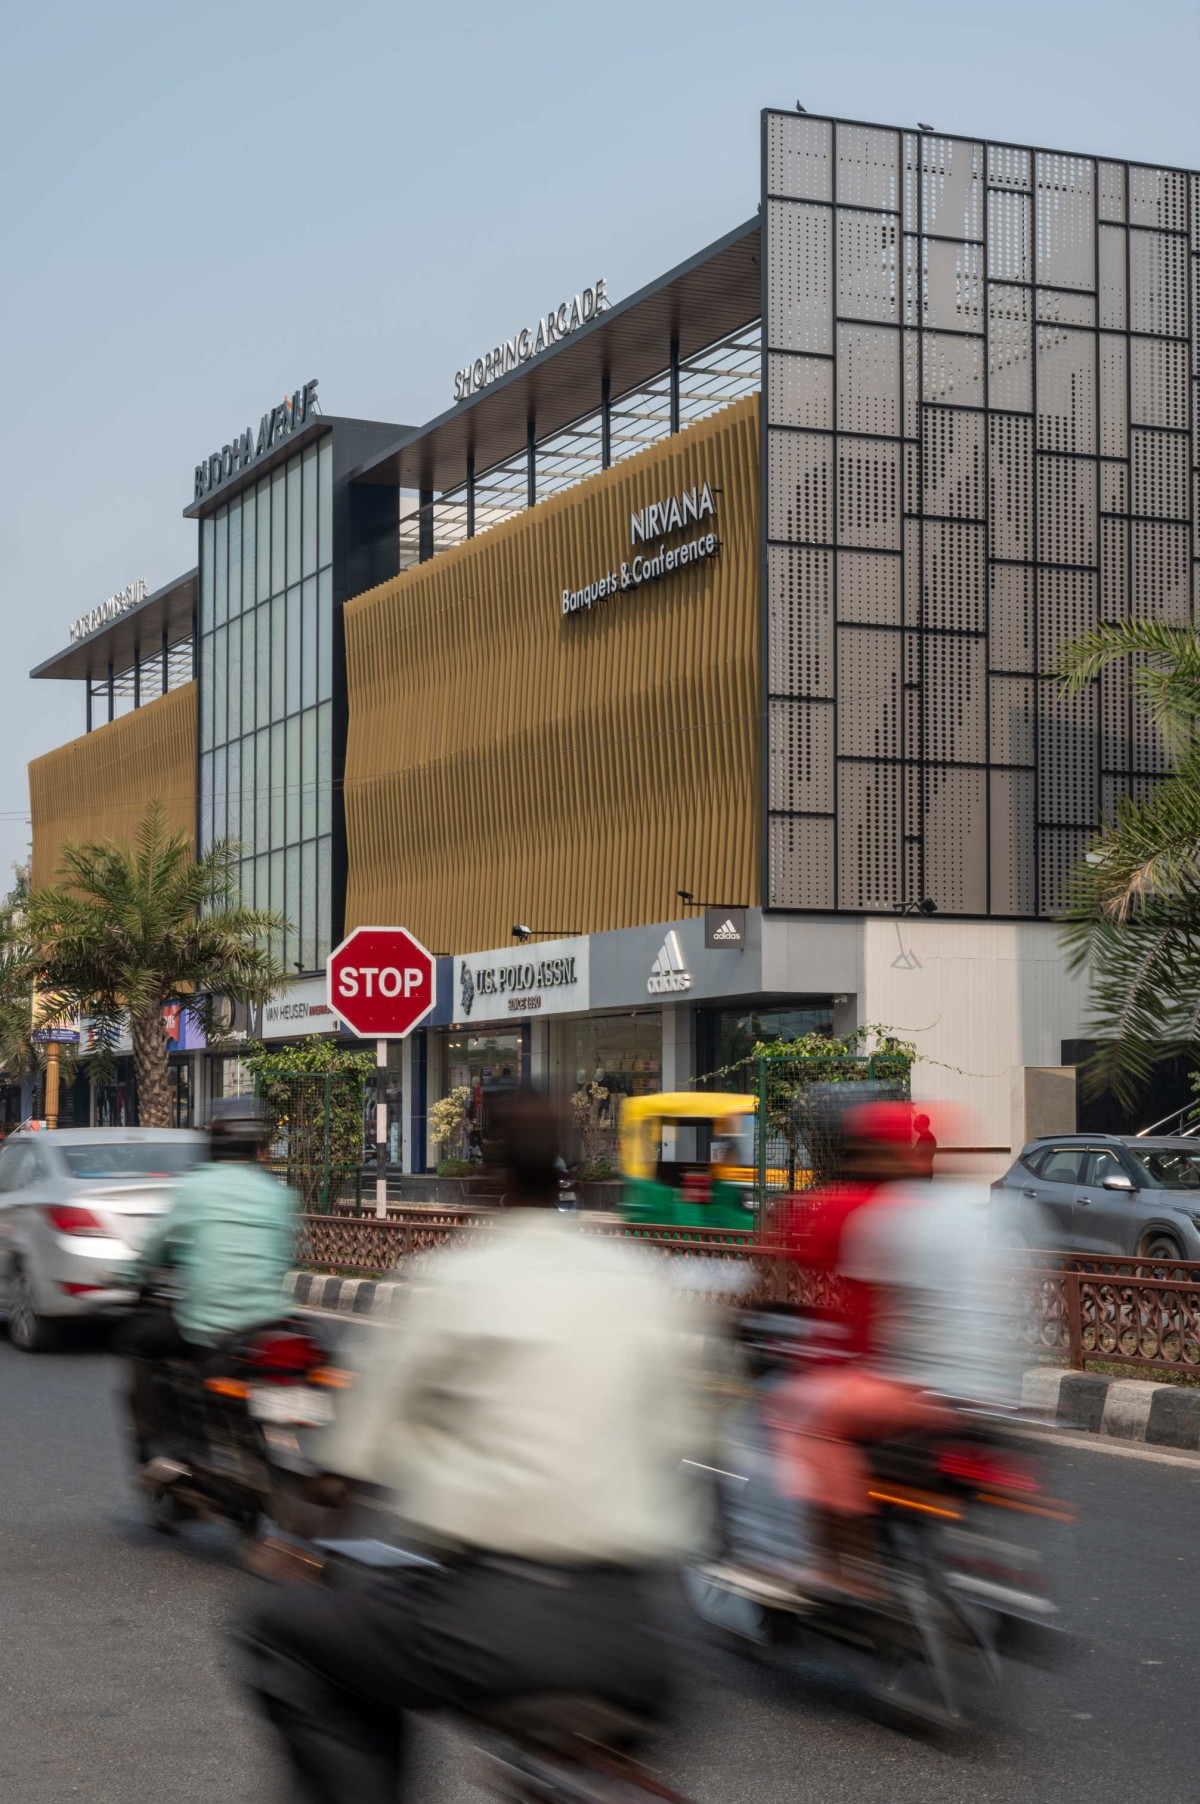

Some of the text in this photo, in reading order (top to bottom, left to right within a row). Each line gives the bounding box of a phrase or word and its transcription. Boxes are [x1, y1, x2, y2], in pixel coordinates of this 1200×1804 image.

[453, 278, 608, 401] SHOPPING ARCADE
[255, 378, 319, 457] AVENUE
[630, 482, 716, 545] NIRVANA
[562, 533, 718, 615] Banquets & Conference
[713, 931, 741, 940] adidas
[338, 967, 424, 998] STOP
[474, 956, 578, 995] U.S. POLO ASSN.
[647, 972, 693, 994] adidas
[265, 1006, 279, 1022] VAN
[279, 1003, 309, 1020] HEUSEN
